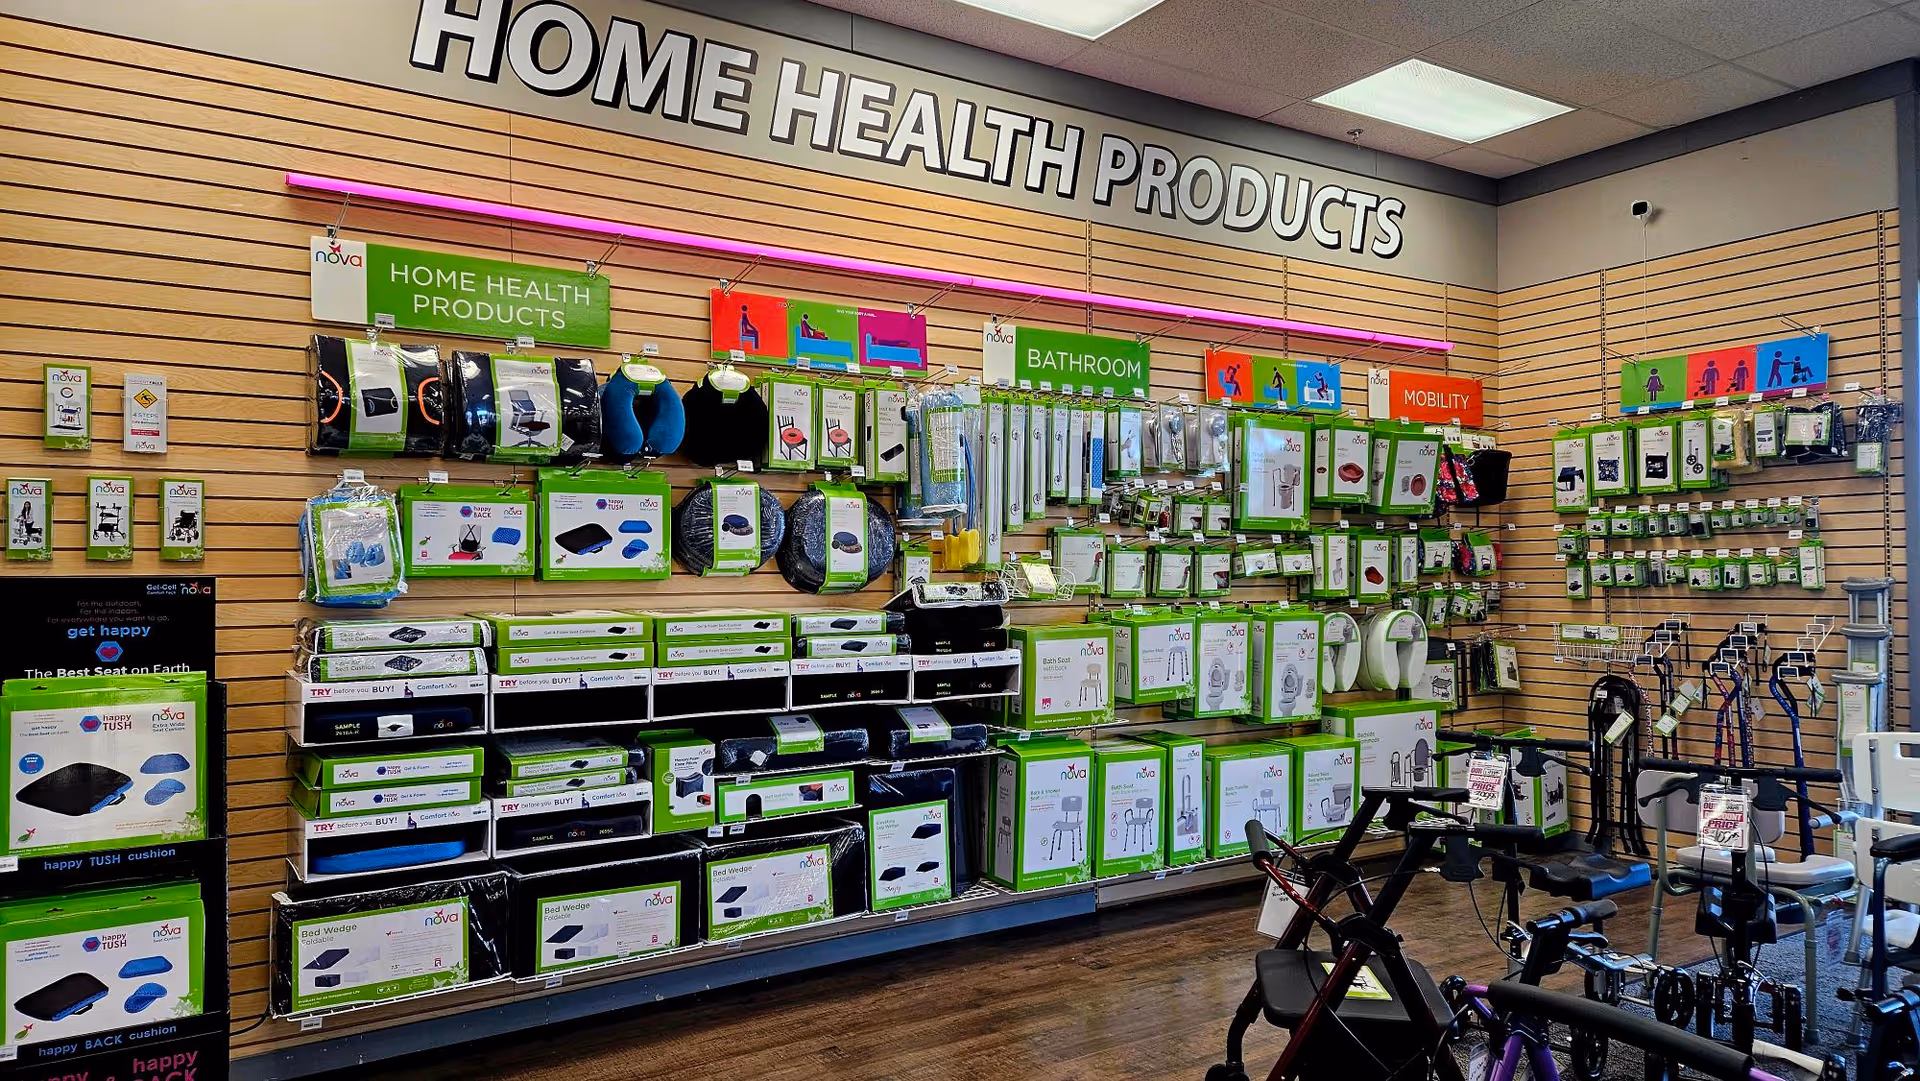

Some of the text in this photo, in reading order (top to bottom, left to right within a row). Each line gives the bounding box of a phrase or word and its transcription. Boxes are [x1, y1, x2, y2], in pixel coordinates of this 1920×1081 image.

[409, 0, 1406, 259] HOME HEALTH PRODUCTS
[315, 246, 363, 268] nova
[390, 262, 590, 306] HOME HEALTH
[413, 294, 566, 330] PRODUCTS
[986, 329, 1014, 345] nova
[1027, 348, 1142, 380] BATHROOM
[531, 367, 550, 376] nova
[52, 373, 82, 383] nova
[1370, 373, 1388, 386] nova
[794, 389, 809, 397] nova
[888, 396, 905, 404] nova
[1404, 389, 1470, 410] MOBILITY
[1280, 440, 1301, 452] nova
[1352, 436, 1367, 446] nova
[1376, 442, 1388, 450] nova
[1418, 446, 1436, 457] nova
[12, 486, 42, 495] nova
[96, 485, 125, 494] nova
[170, 487, 198, 496] nova
[736, 489, 753, 497] nova
[640, 500, 659, 508] nova
[1087, 542, 1101, 550] nova
[1374, 544, 1387, 552] nova
[182, 586, 211, 595] nova
[67, 624, 151, 639] get happy
[1116, 631, 1129, 639] nova
[1168, 629, 1191, 642] nova
[1226, 626, 1245, 637] nova
[1297, 630, 1315, 640] nova
[1081, 642, 1104, 656] nova
[25, 663, 191, 679] The Best Seat on Earth
[310, 688, 332, 696] TRY
[372, 685, 395, 693] BUY!
[103, 714, 132, 723] happy
[152, 710, 185, 721] nova
[103, 722, 132, 732] TUSH
[1414, 718, 1434, 731] nova
[1334, 754, 1353, 766] nova
[339, 771, 359, 779] nova
[1000, 767, 1013, 776] nova
[1060, 767, 1087, 781] nova
[1136, 769, 1156, 779] nova
[1264, 767, 1283, 778] nova
[1471, 782, 1497, 791] PRICE
[501, 803, 520, 811] TRY
[554, 797, 573, 806] BUY!
[420, 812, 448, 820] Comfort
[923, 811, 942, 820] nova
[313, 823, 335, 832] TRY
[375, 816, 398, 826] BUY!
[1708, 820, 1739, 830] PRICE
[44, 847, 176, 871] happy TUSH cushion
[800, 856, 824, 869] nova
[713, 864, 753, 877] Bed Wedge
[645, 894, 673, 907] nova
[544, 902, 591, 915] Bed Wedge
[425, 912, 459, 927] nova
[543, 913, 572, 921] Foldable
[152, 926, 181, 938] nova
[301, 922, 358, 938] Bed Wedge
[101, 932, 127, 942] happy
[301, 936, 334, 946] Foldable
[102, 940, 127, 950] TUSH
[38, 1024, 177, 1057] happy BACK cushion
[132, 1051, 199, 1074] happy
